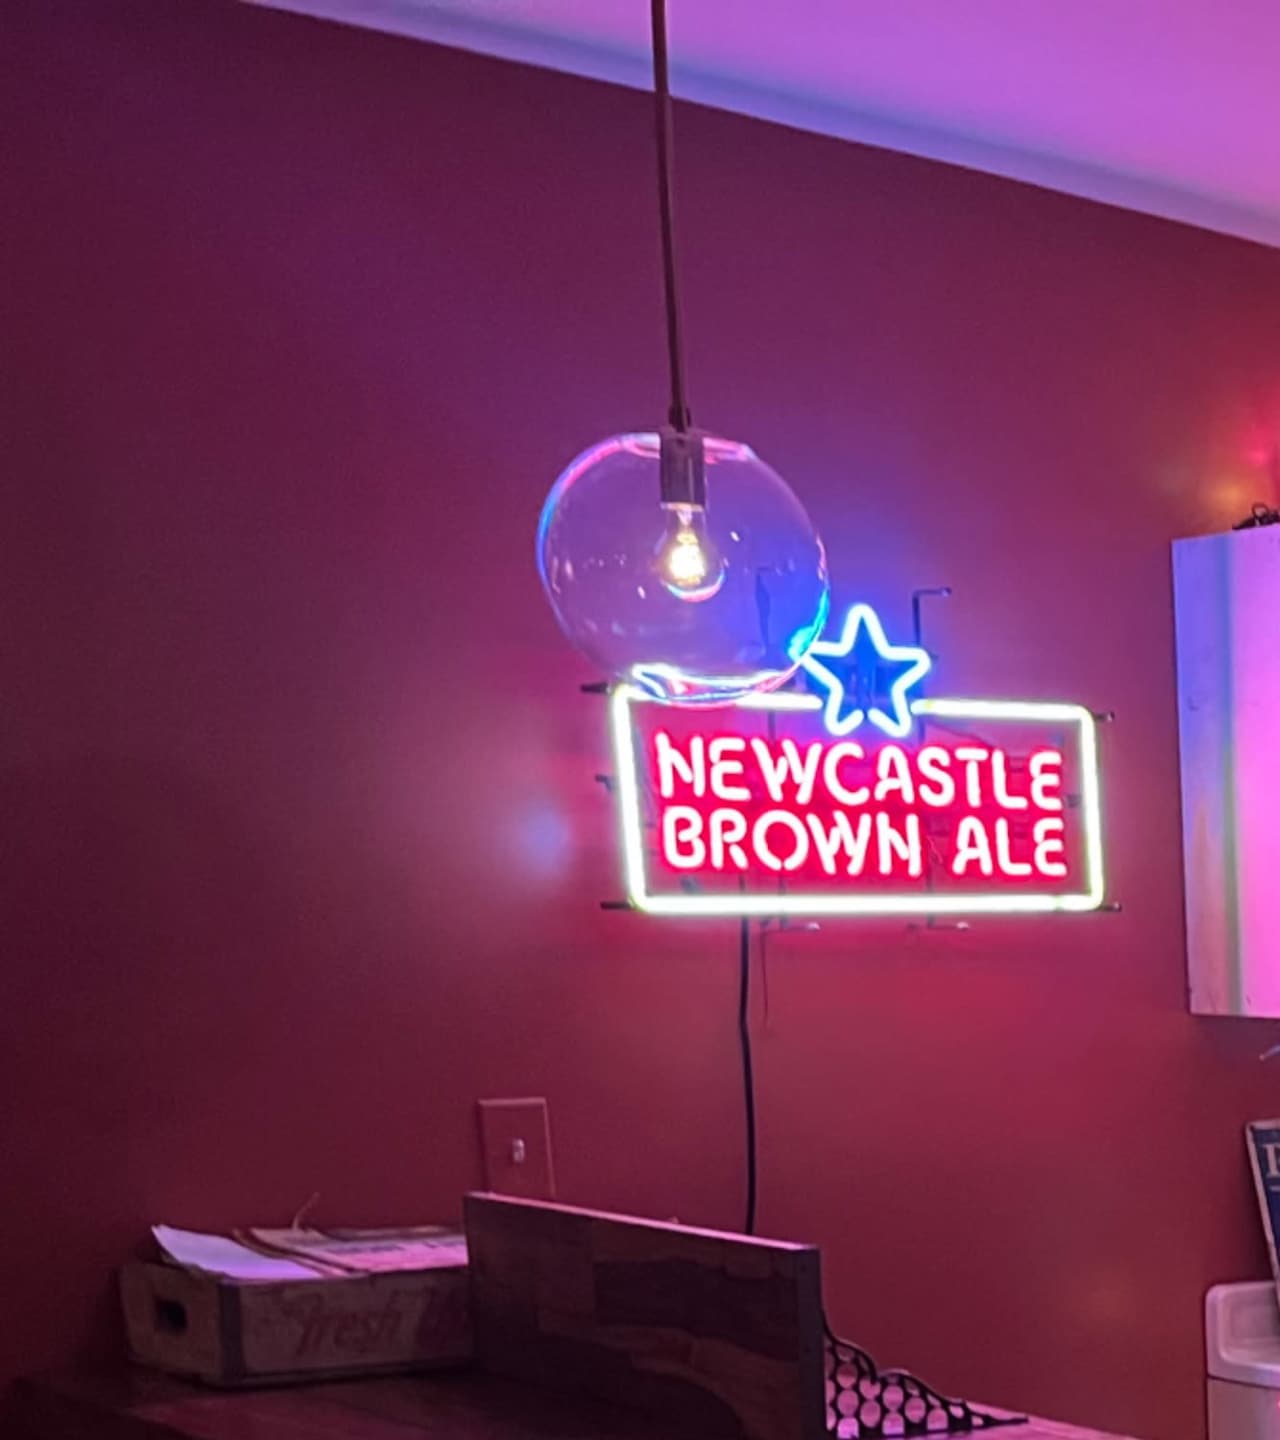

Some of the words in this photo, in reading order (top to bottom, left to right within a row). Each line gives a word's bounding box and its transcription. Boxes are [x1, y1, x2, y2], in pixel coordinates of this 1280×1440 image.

[653, 731, 1064, 812] NEWCASTLE
[661, 805, 923, 878] BROWN
[951, 815, 1069, 878] ALE
